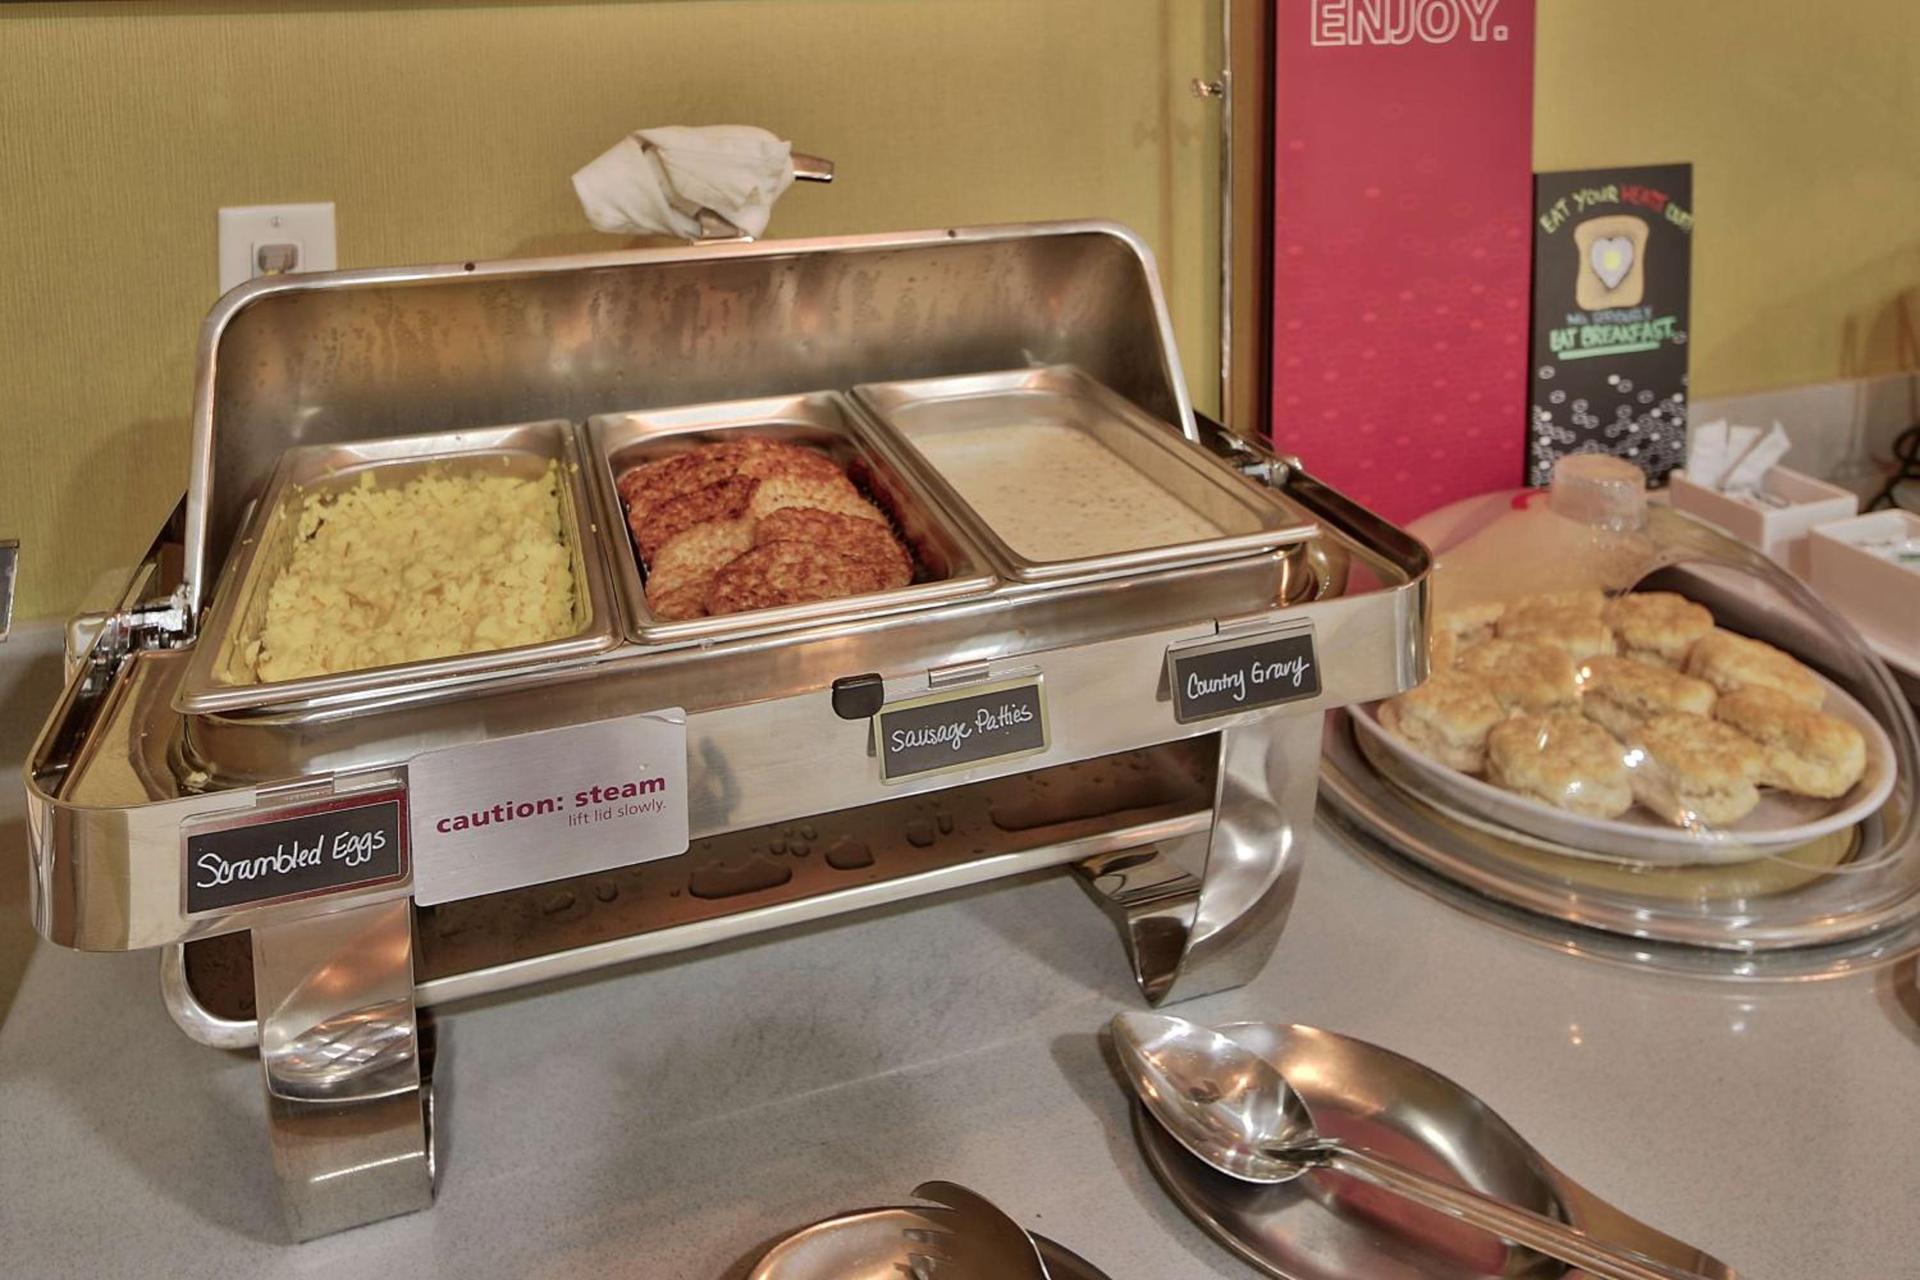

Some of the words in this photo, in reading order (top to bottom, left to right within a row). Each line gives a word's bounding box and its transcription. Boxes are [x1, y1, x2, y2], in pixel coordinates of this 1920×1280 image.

[1311, 0, 1508, 46] ENJOY.
[1539, 197, 1571, 234] EAT
[1572, 183, 1620, 212] YOUR
[1550, 328, 1578, 352] EAT
[1187, 669, 1246, 701] Country
[1251, 656, 1310, 687] Gravy
[891, 721, 972, 752] Sausage
[975, 703, 1034, 734] Patties
[436, 796, 564, 833] caution:
[575, 777, 666, 807] steam
[568, 811, 590, 827] lift
[594, 809, 612, 822] lid
[617, 799, 667, 818] slowly.
[197, 834, 325, 888] Scrambled
[332, 830, 386, 866] Eggs
